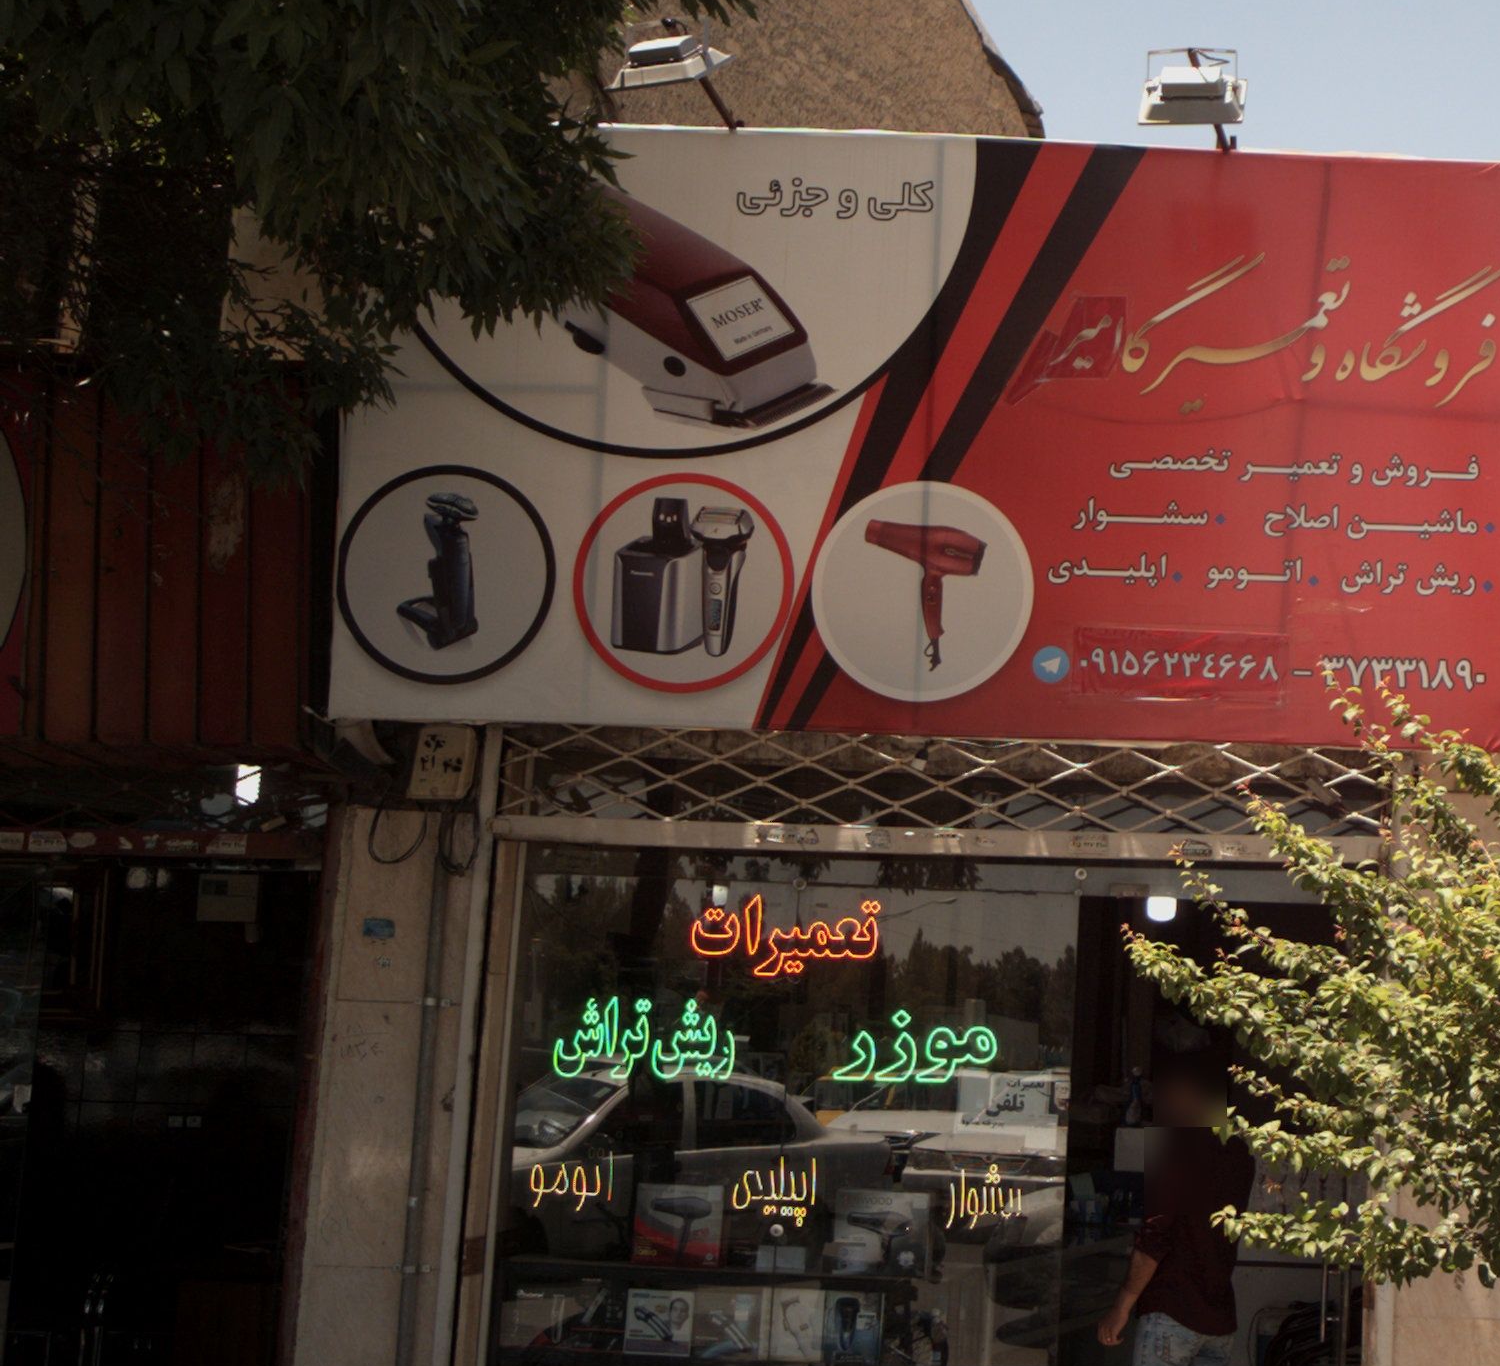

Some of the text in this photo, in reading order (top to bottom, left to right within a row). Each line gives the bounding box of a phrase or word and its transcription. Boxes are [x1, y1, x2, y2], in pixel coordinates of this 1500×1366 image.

[736, 177, 934, 221] کلی و جزئی
[711, 299, 764, 329] MOSER
[1049, 314, 1124, 371] امیر
[1302, 342, 1326, 382] و
[1109, 448, 1480, 487] فروش و تعمیر تخصصی
[1073, 497, 1209, 531] سشوار
[1263, 504, 1479, 540] ماشین اصلاح
[1047, 553, 1169, 589] اپلیدی
[1205, 556, 1303, 591] اتومو
[1340, 560, 1477, 597] ریش تراش
[1320, 654, 1487, 691] ۳۷۳۳۱۸۹۰
[691, 893, 882, 977] تعمیرات
[552, 995, 736, 1081] ریش تراش
[832, 1008, 998, 1085] موزر
[945, 1162, 1023, 1231] سشوار
